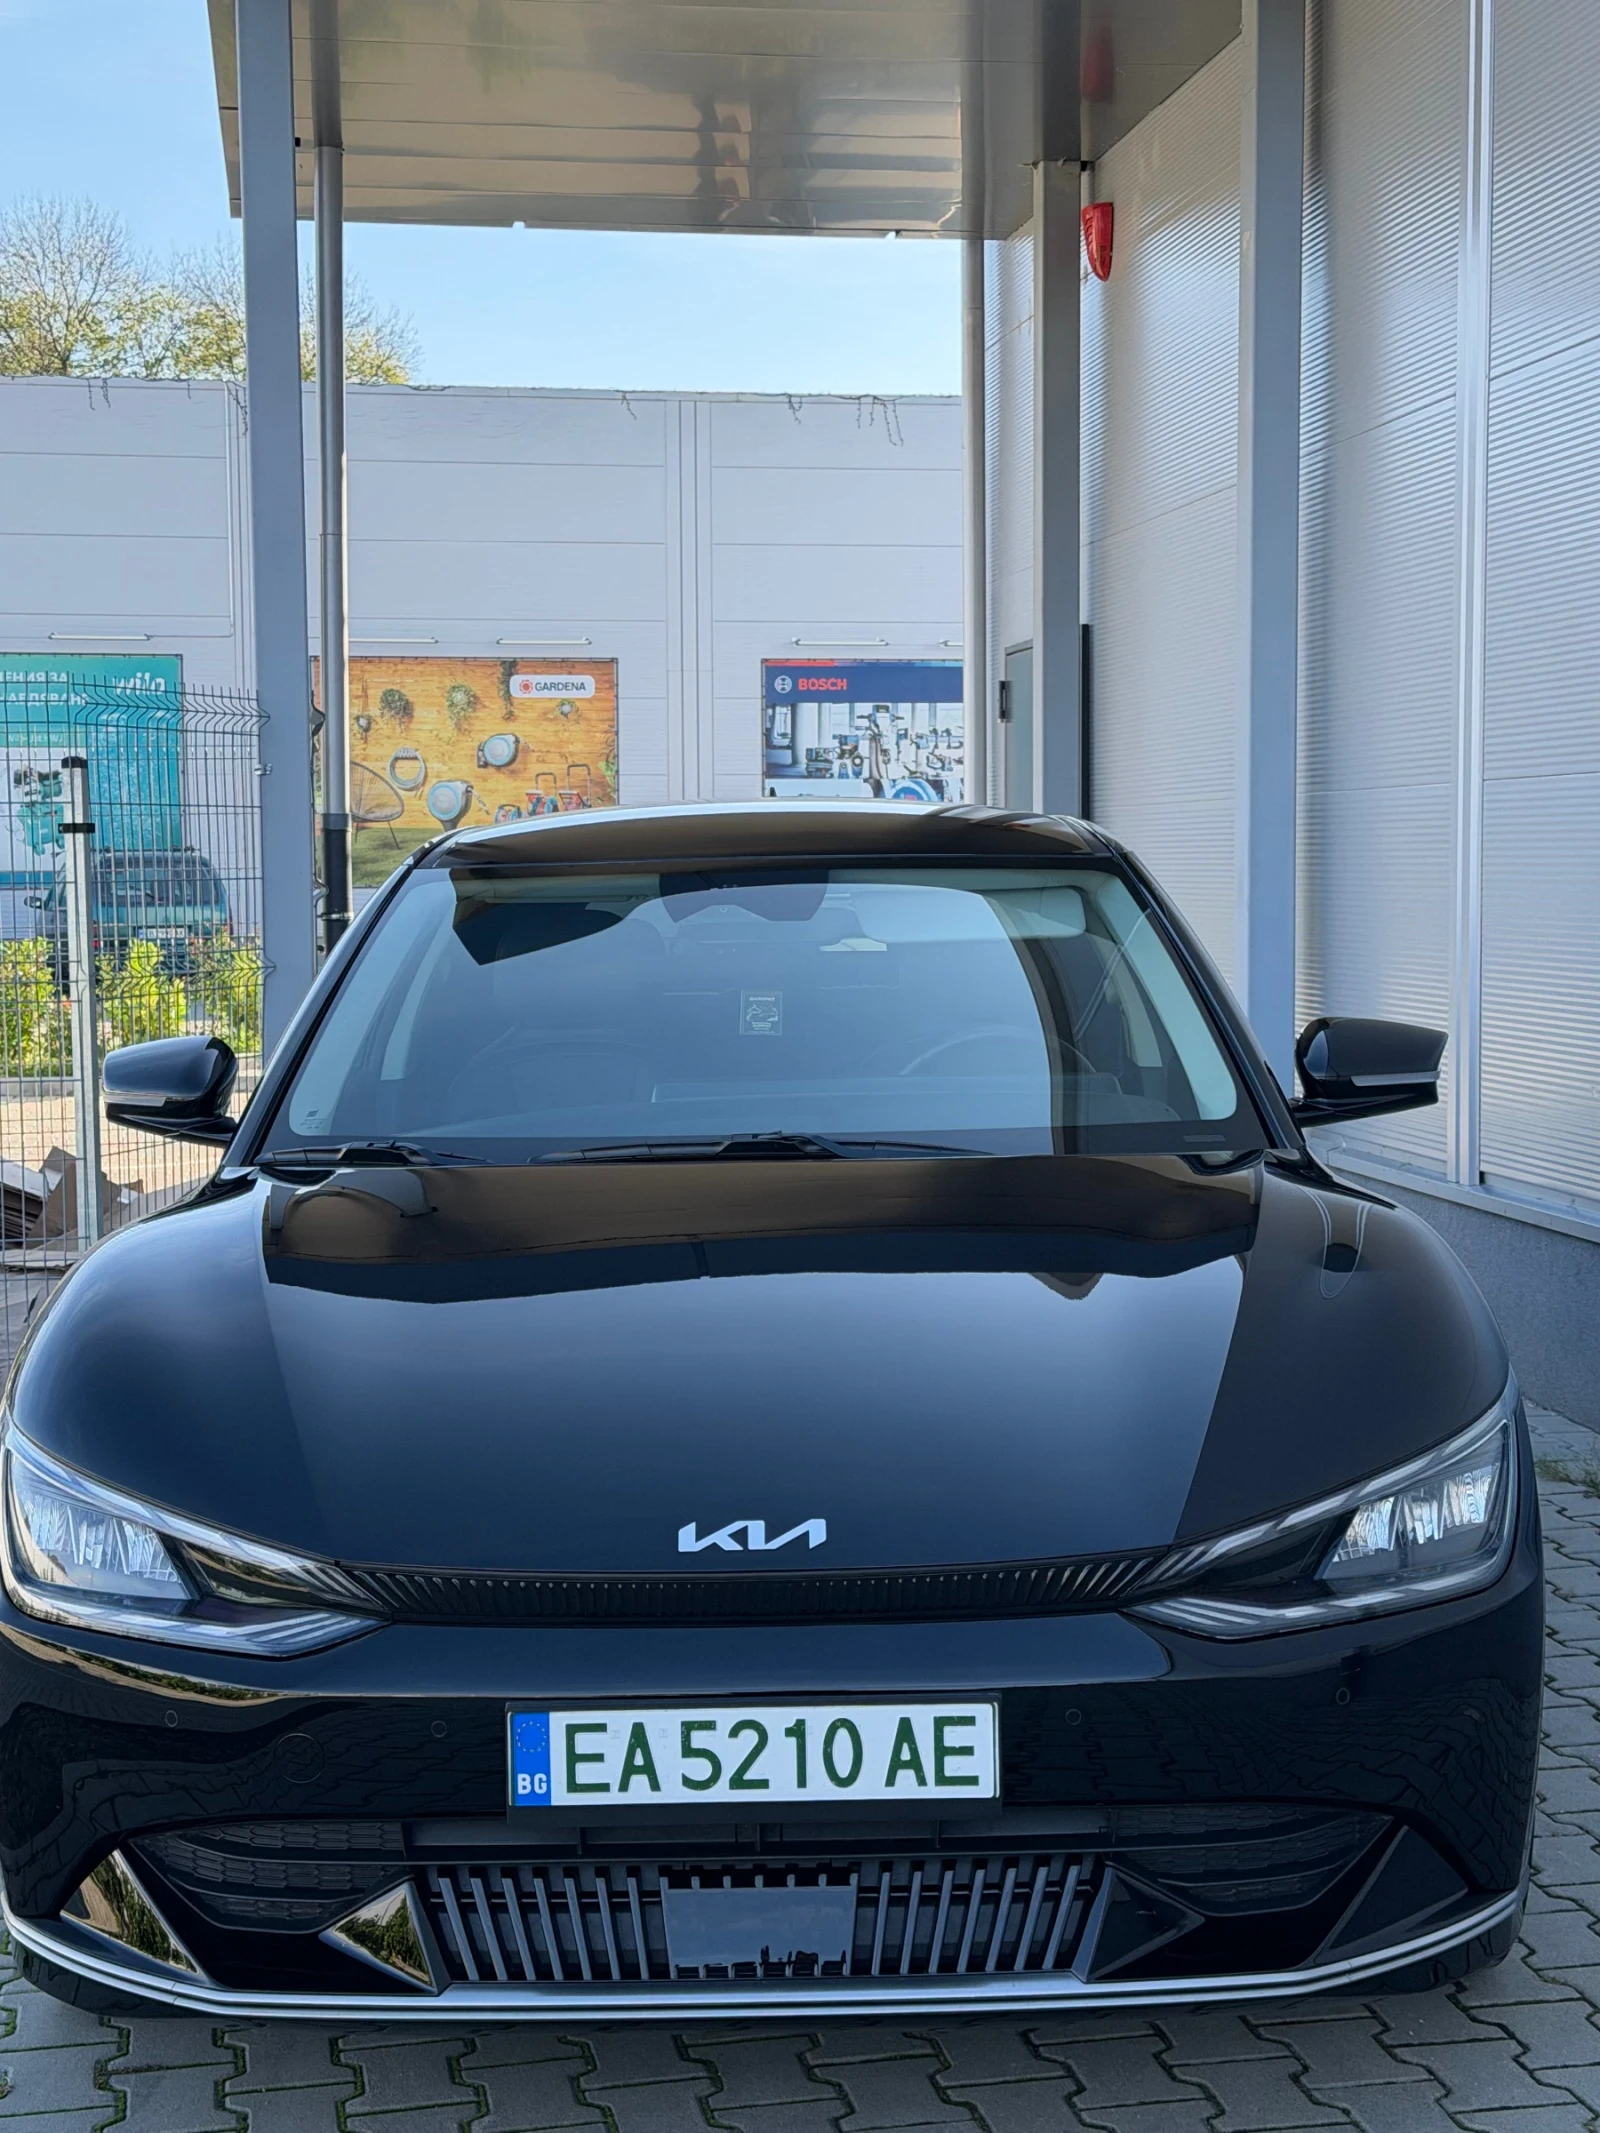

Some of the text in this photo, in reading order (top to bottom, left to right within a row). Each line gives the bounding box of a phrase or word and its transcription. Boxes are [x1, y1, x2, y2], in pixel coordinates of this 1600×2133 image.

[49, 672, 69, 683] ЗА
[112, 672, 165, 696] wilo
[534, 682, 586, 691] GARDENA
[798, 677, 847, 691] BOSCH
[677, 1518, 827, 1552] KIA
[565, 1715, 980, 1794] EA 5210 AE
[517, 1773, 548, 1796] BG
